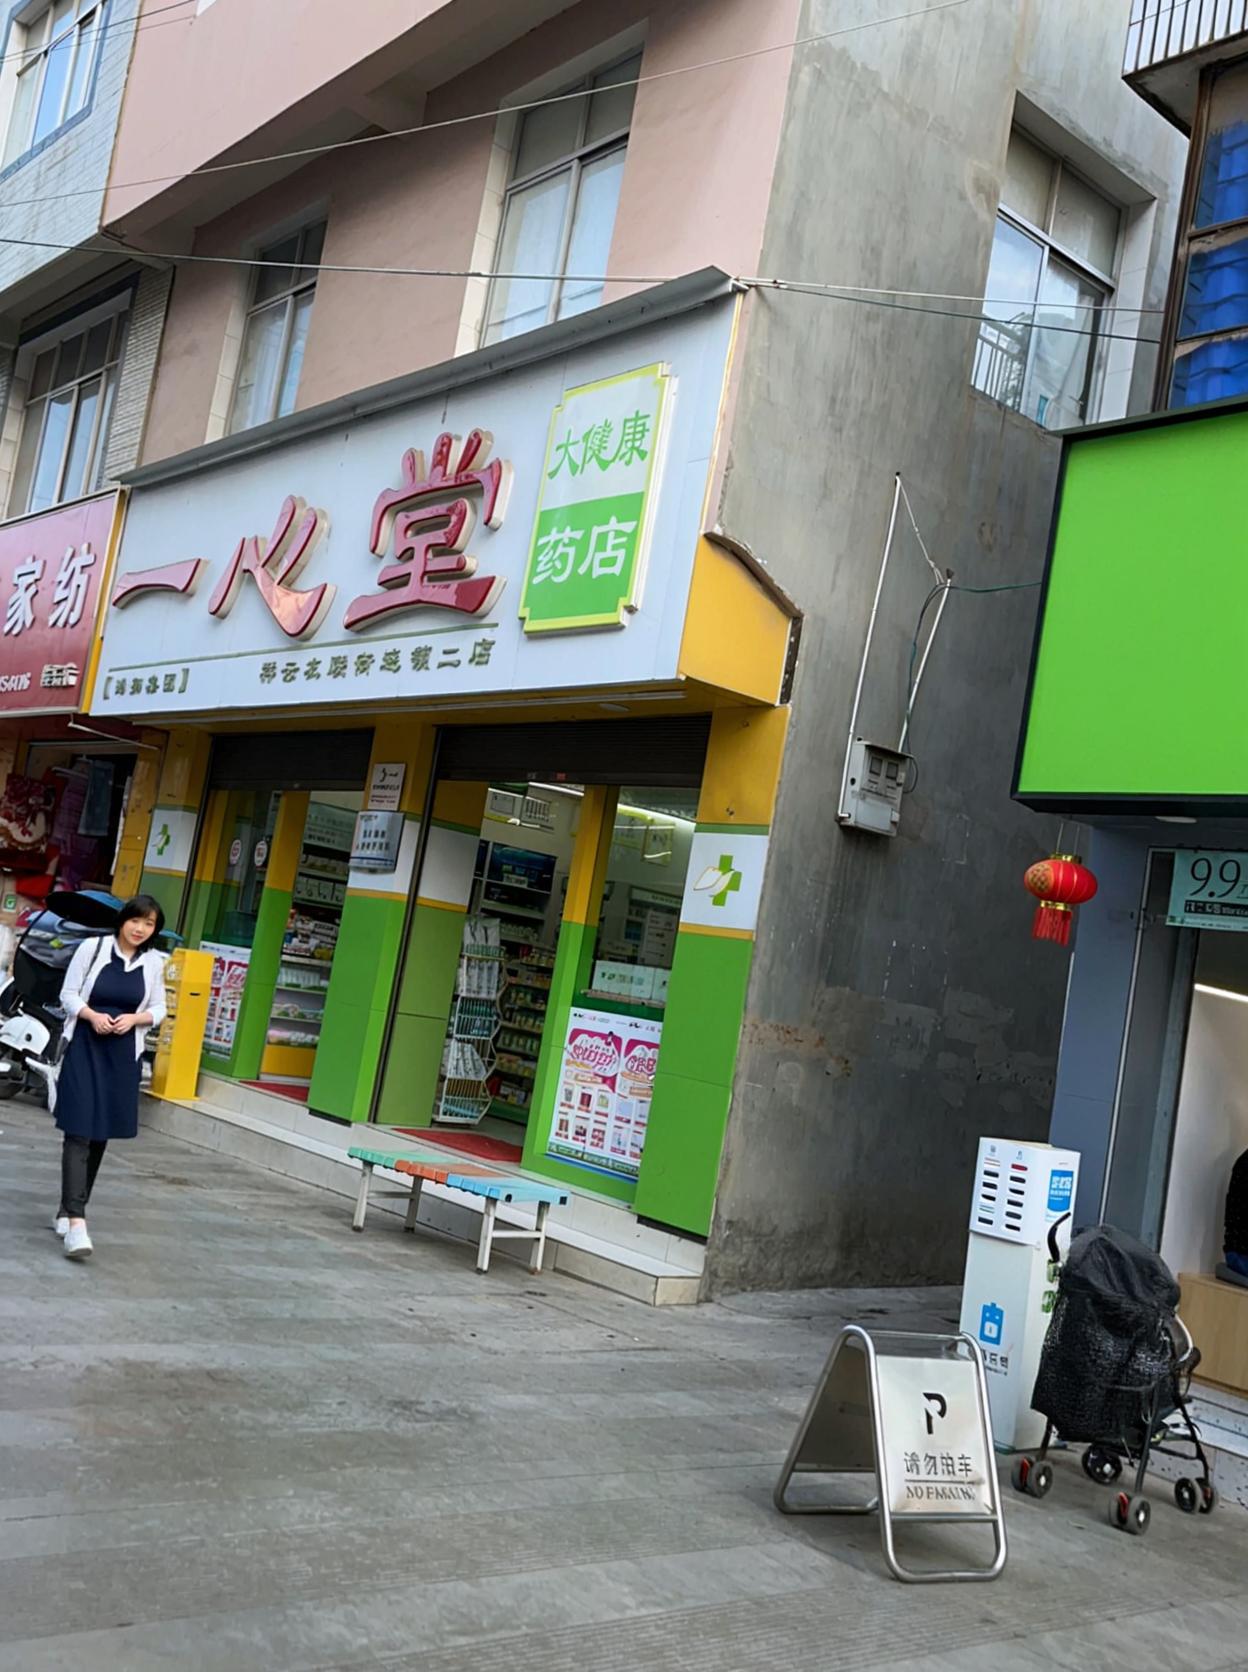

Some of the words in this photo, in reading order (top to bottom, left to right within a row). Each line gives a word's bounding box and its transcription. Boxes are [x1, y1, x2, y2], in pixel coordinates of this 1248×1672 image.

[547, 410, 651, 479] 大健康
[112, 428, 512, 638] 一心堂
[532, 516, 637, 584] 药店
[4, 542, 96, 636] 家纺
[922, 1392, 947, 1434] P
